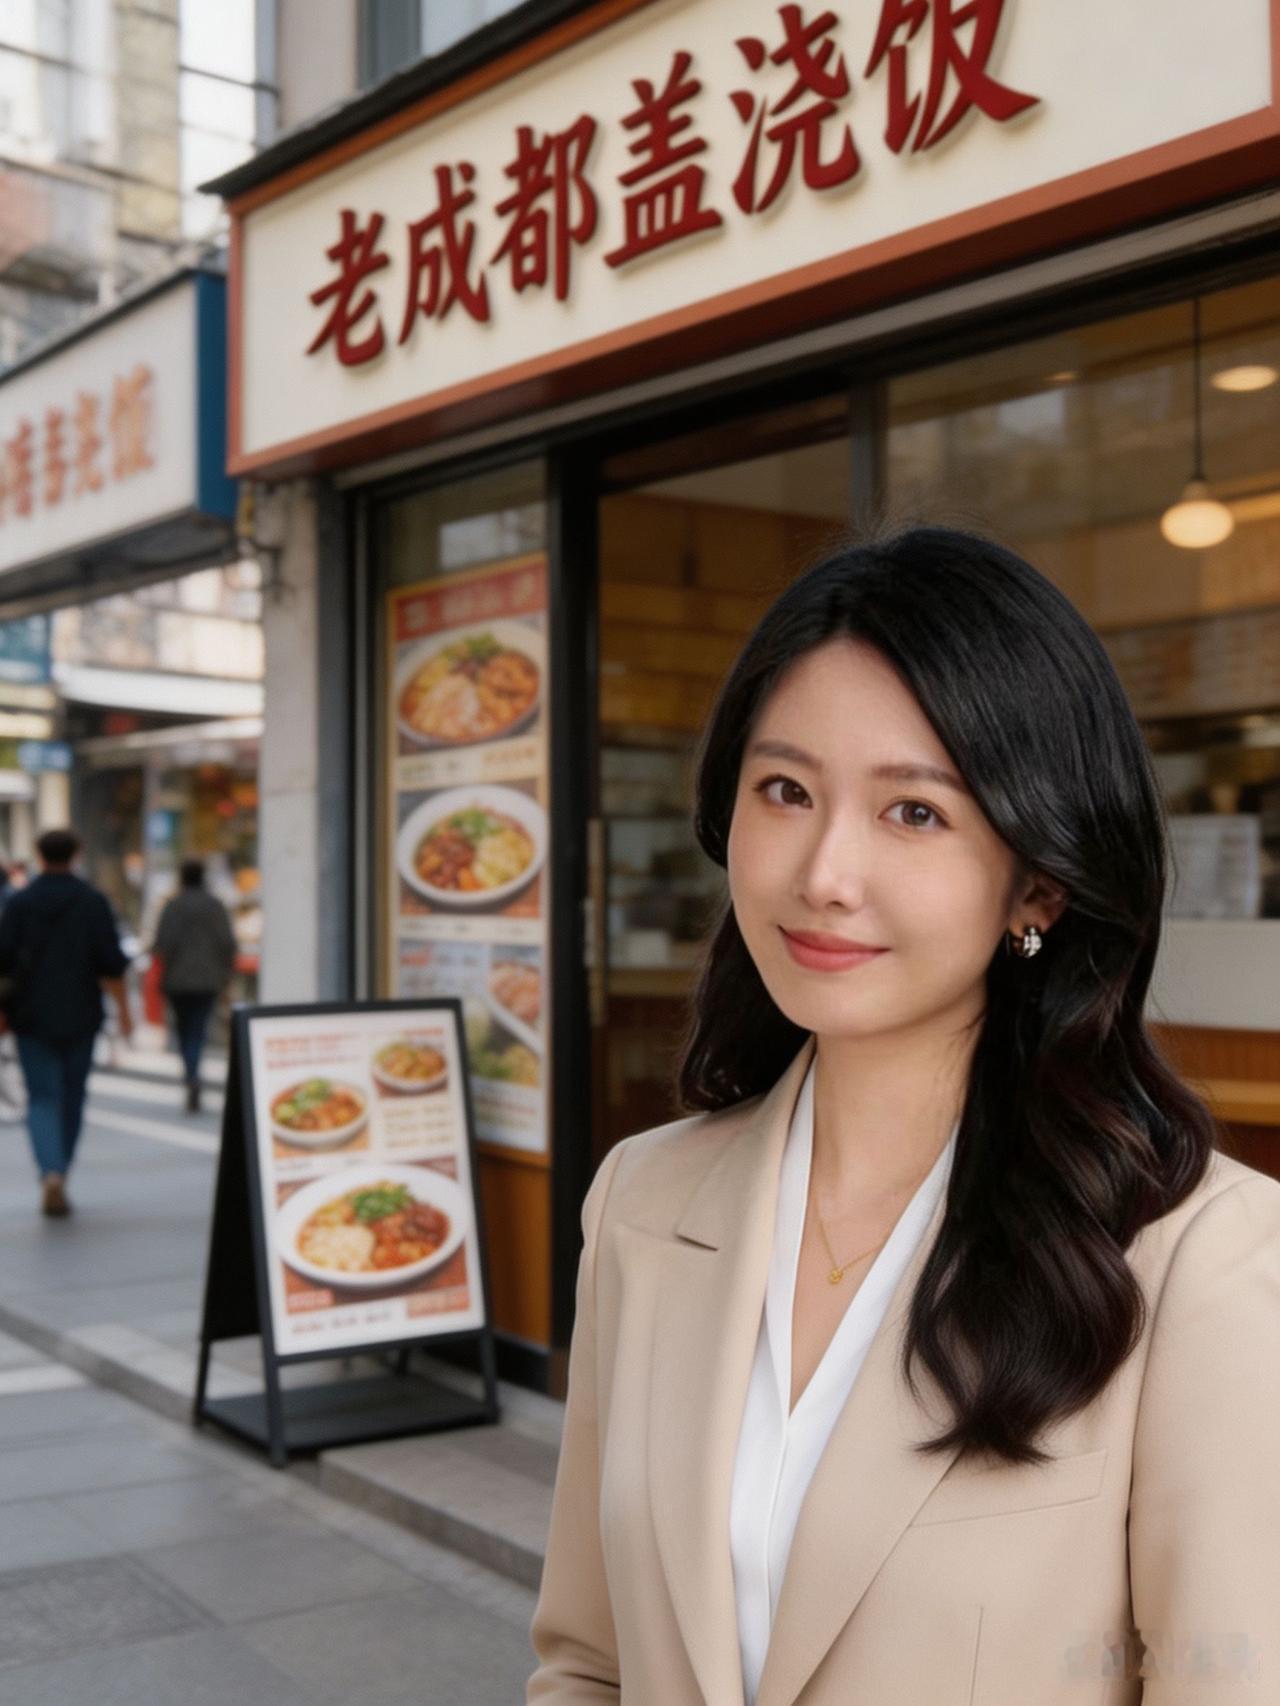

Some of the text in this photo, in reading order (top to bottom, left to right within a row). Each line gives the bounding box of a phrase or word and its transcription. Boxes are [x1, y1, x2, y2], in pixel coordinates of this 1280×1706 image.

[306, 0, 1041, 366] 老成都盖浇饭
